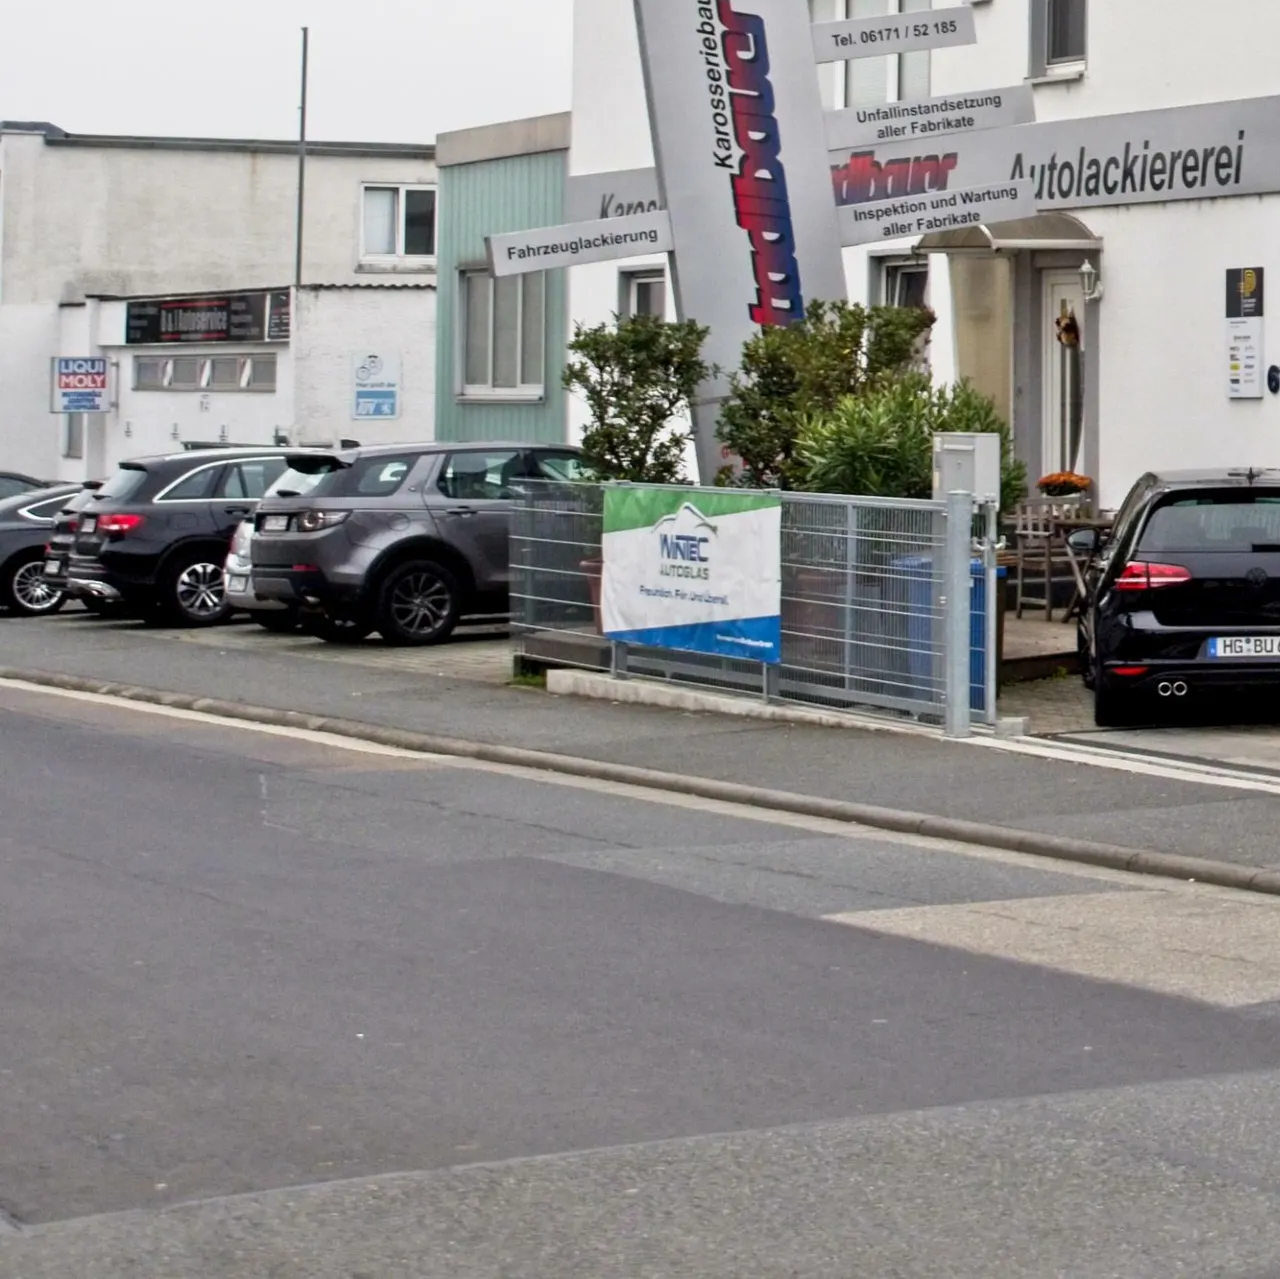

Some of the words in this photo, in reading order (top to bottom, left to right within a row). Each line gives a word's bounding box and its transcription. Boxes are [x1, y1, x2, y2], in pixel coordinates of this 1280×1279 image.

[832, 33, 857, 48] Tel.
[860, 27, 900, 43] 06171
[913, 23, 929, 37] 52
[934, 20, 957, 35] 185
[856, 94, 1002, 124] Unfallinstandsetzung
[877, 125, 908, 139] aller
[911, 115, 975, 134] Fabrikate
[1010, 130, 1245, 200] Autolackiererei
[853, 201, 928, 223] Inspektion
[931, 192, 957, 208] und
[961, 186, 1018, 206] Wartung
[883, 222, 914, 237] aller
[917, 210, 981, 231] Fabrikate
[507, 229, 658, 260] Fahrzeuglackierung
[60, 360, 104, 373] LIQUI
[60, 375, 104, 388] MOLY
[659, 533, 710, 562] WINTEC
[659, 564, 710, 581] AUTOGLAS
[1223, 639, 1244, 655] HG
[1253, 639, 1275, 654] BU
